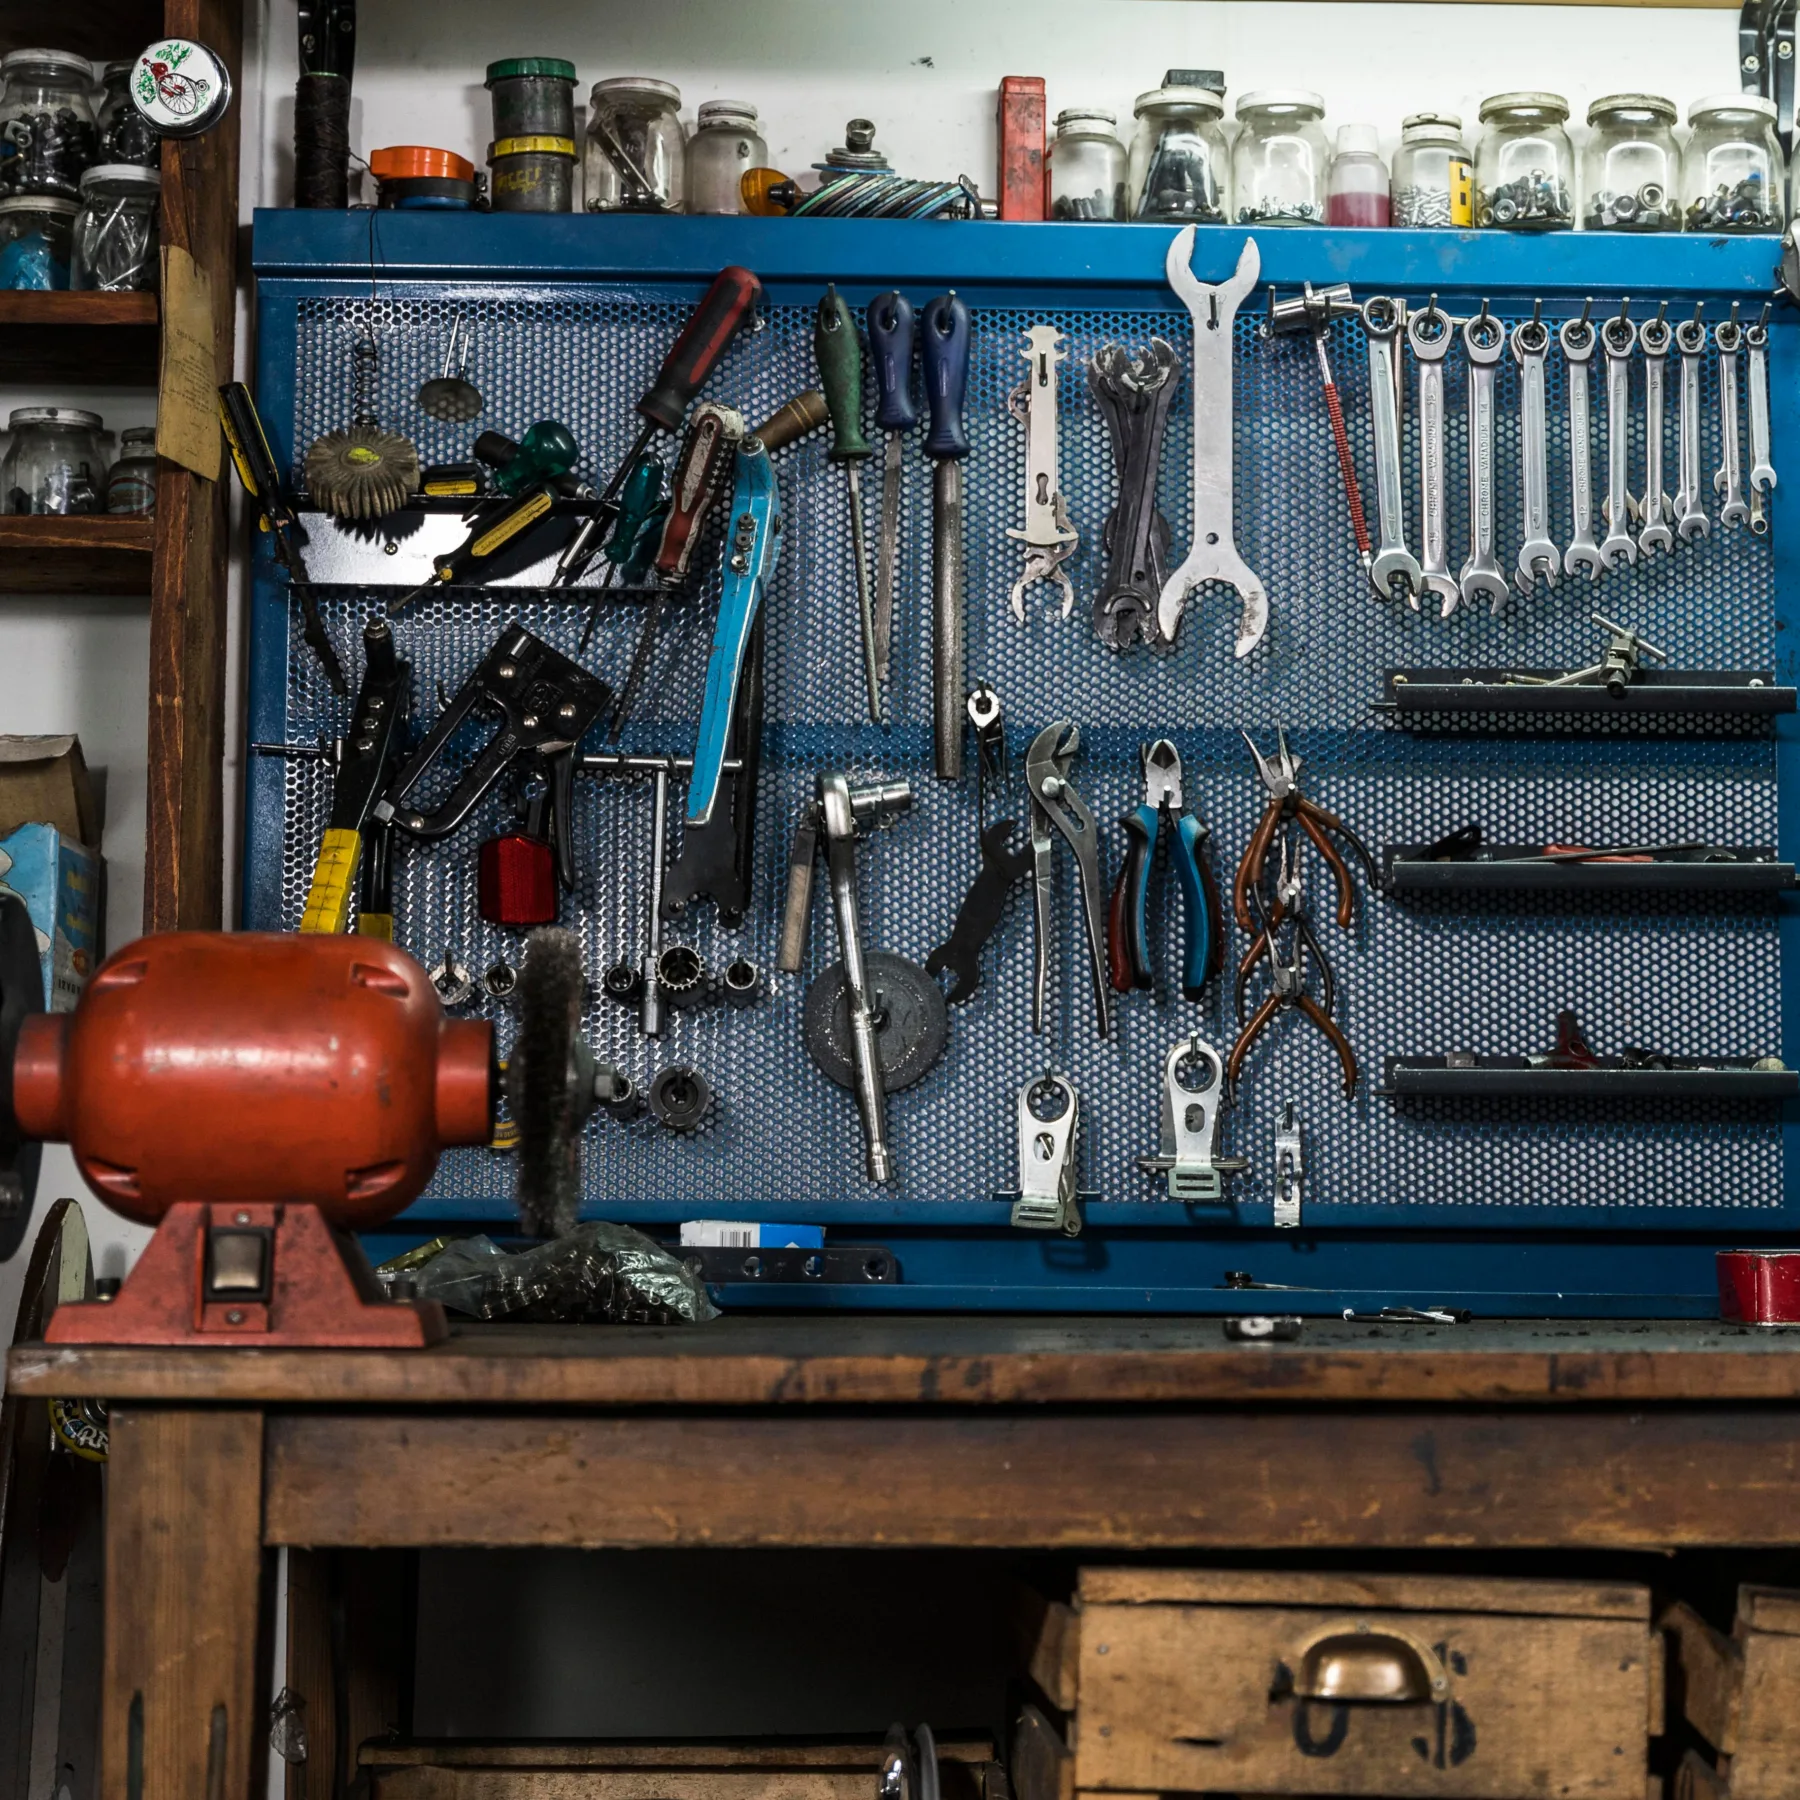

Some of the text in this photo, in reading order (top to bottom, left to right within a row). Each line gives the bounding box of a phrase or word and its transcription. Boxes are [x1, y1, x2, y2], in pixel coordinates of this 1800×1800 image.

[1576, 391, 1584, 401] 12
[1427, 418, 1437, 469] VANADIUM
[1577, 413, 1586, 458] VANADIUM
[1480, 403, 1490, 538] 14 CHROME VANADIUM 14
[1579, 460, 1588, 494] CHROME
[1428, 471, 1438, 517] CHROME
